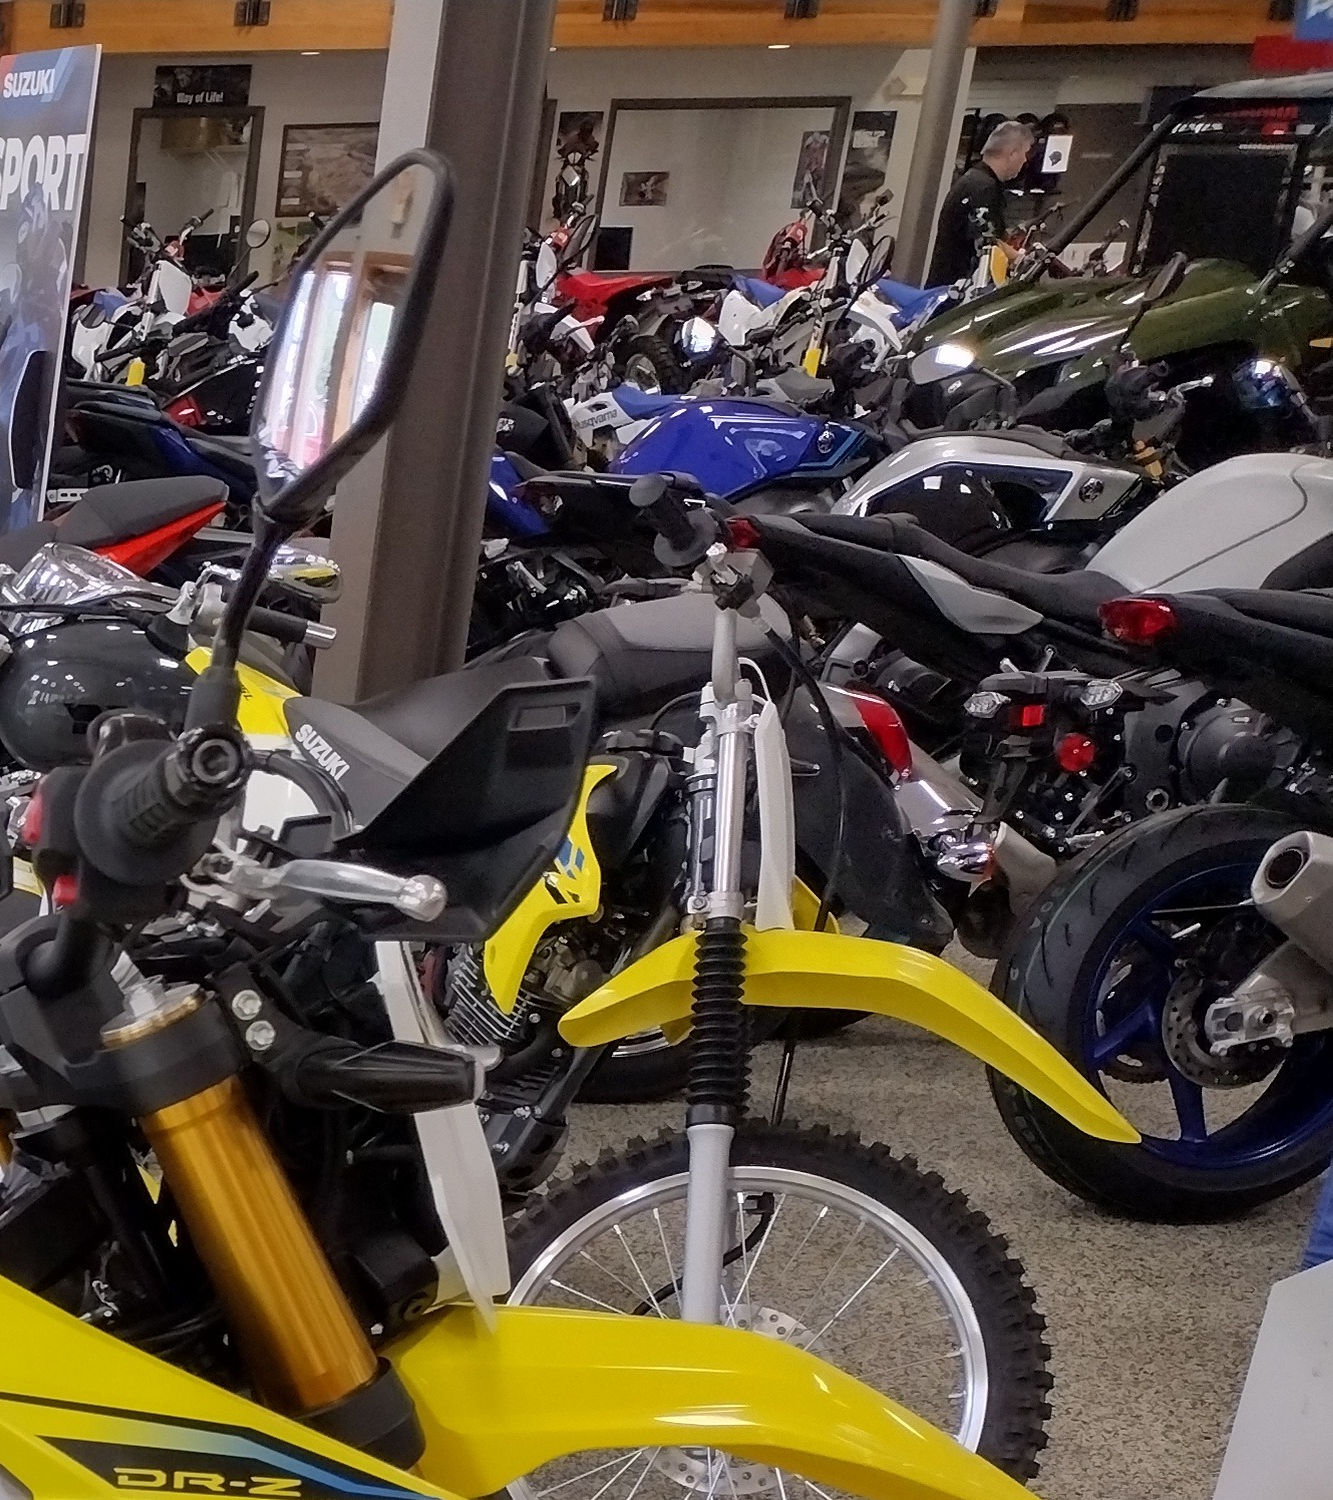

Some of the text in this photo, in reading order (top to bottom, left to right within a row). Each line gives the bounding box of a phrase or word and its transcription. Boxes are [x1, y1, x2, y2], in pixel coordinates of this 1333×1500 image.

[2, 68, 56, 98] SUZUKI
[295, 724, 351, 781] SUZUKI
[112, 1466, 302, 1498] DR-Z
